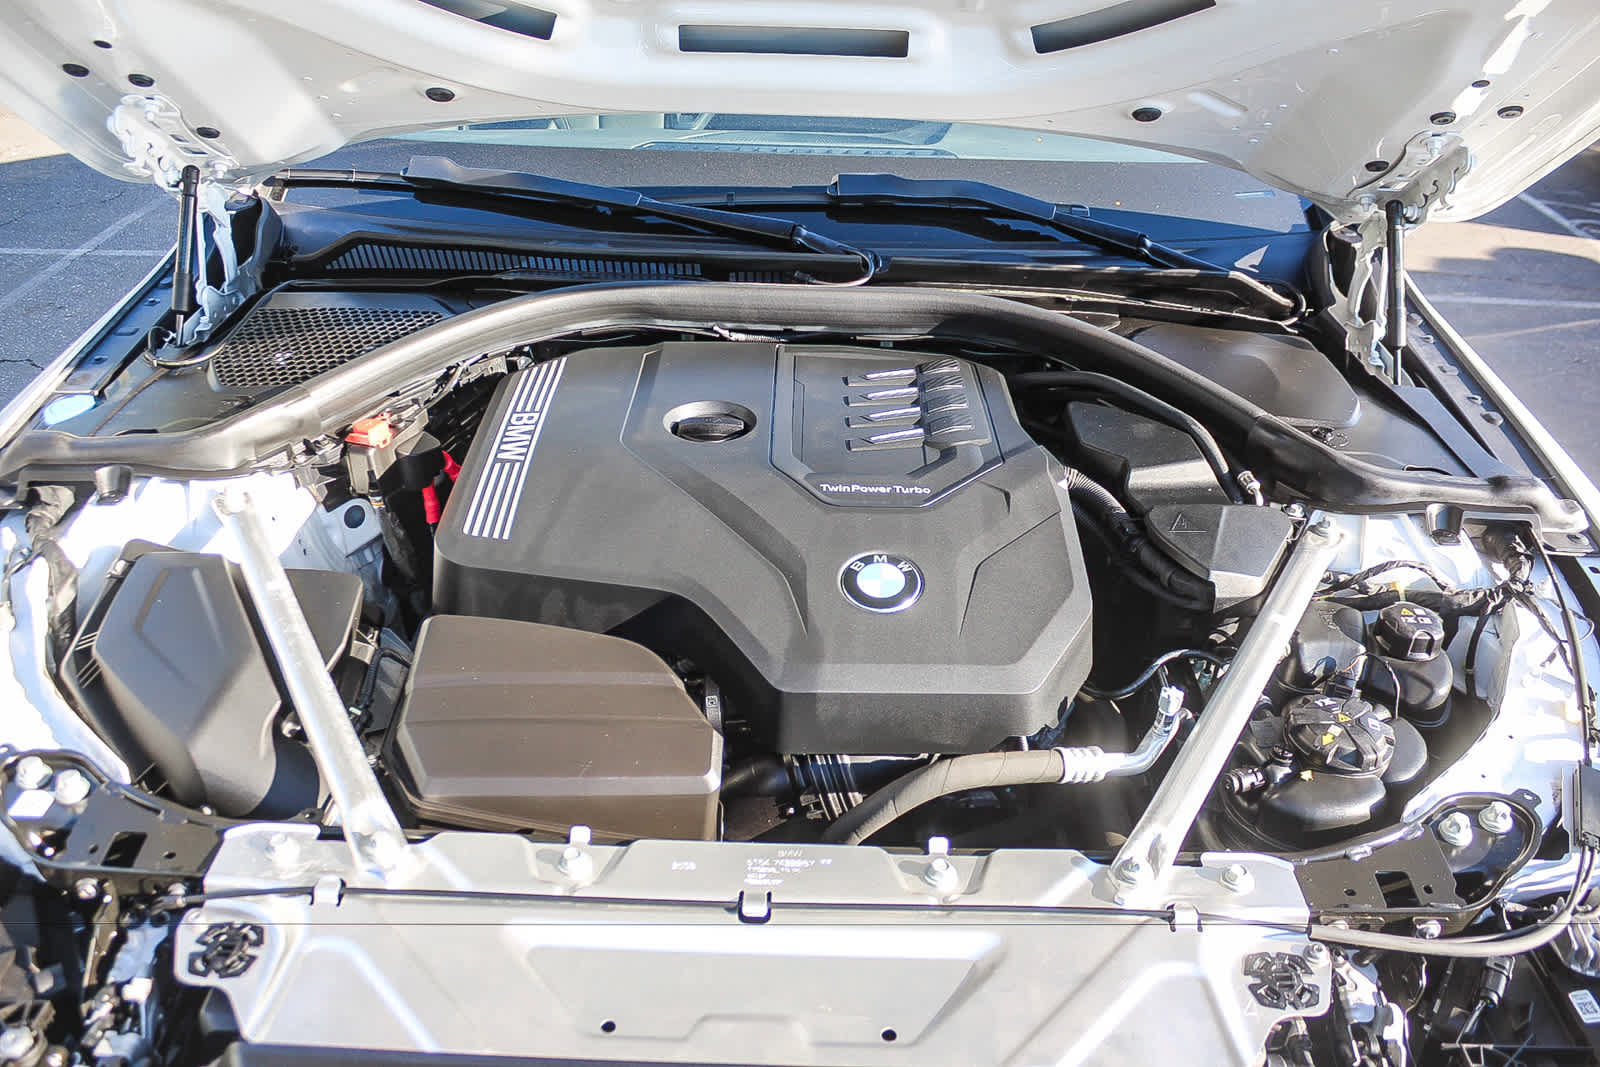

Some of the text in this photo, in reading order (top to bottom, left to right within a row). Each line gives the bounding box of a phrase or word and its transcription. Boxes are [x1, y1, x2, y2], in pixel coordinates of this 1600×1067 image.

[496, 412, 540, 461] BMW
[893, 485, 931, 494] Turbo
[850, 555, 912, 572] BMW
